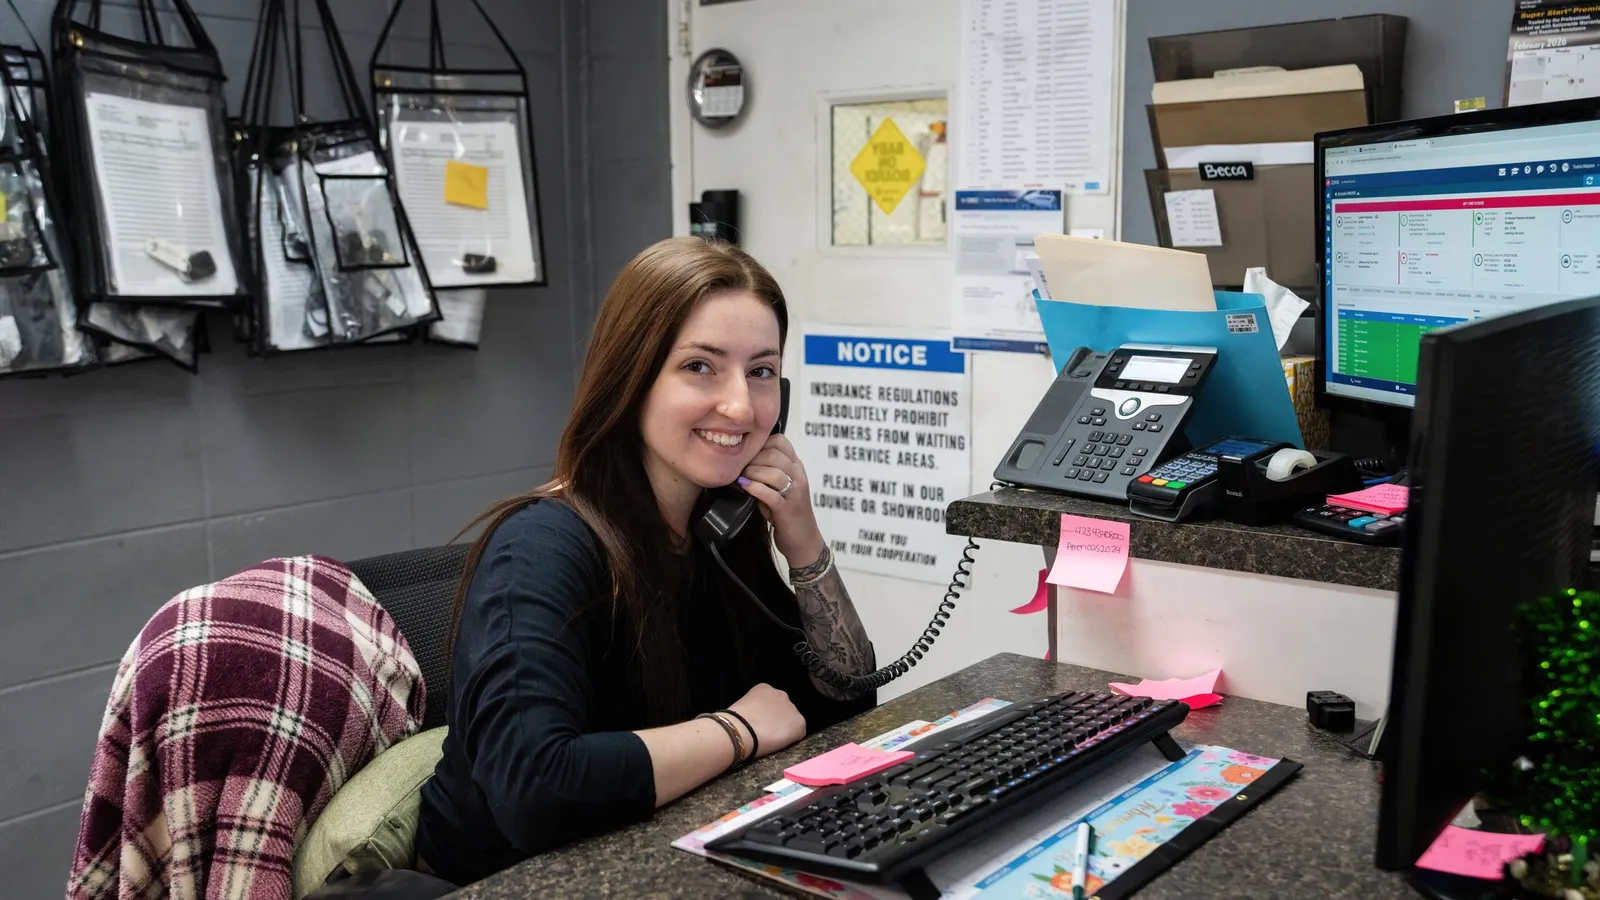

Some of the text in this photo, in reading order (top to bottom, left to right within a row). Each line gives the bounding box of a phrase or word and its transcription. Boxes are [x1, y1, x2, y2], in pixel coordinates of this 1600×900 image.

[1520, 11, 1546, 19] Super
[1513, 37, 1567, 50] February 2026
[1204, 164, 1247, 179] Becca
[837, 341, 928, 366] NOTICE
[810, 382, 958, 406] INSURANCE REGULATIONS
[819, 403, 949, 427] ABSOLUTELY PROHIBIT
[805, 422, 965, 450] CUSTOMERS FROM WAITING
[828, 444, 939, 470] IN SERVICE AREAS.
[822, 473, 945, 502] PLEASE WAIT IN OUR
[1225, 489, 1243, 498] Scotch
[813, 492, 855, 512] LOUNGE
[861, 499, 876, 514] OR
[858, 528, 908, 546] THANK YOU
[830, 540, 937, 566] FOR YOUR COOPERATION
